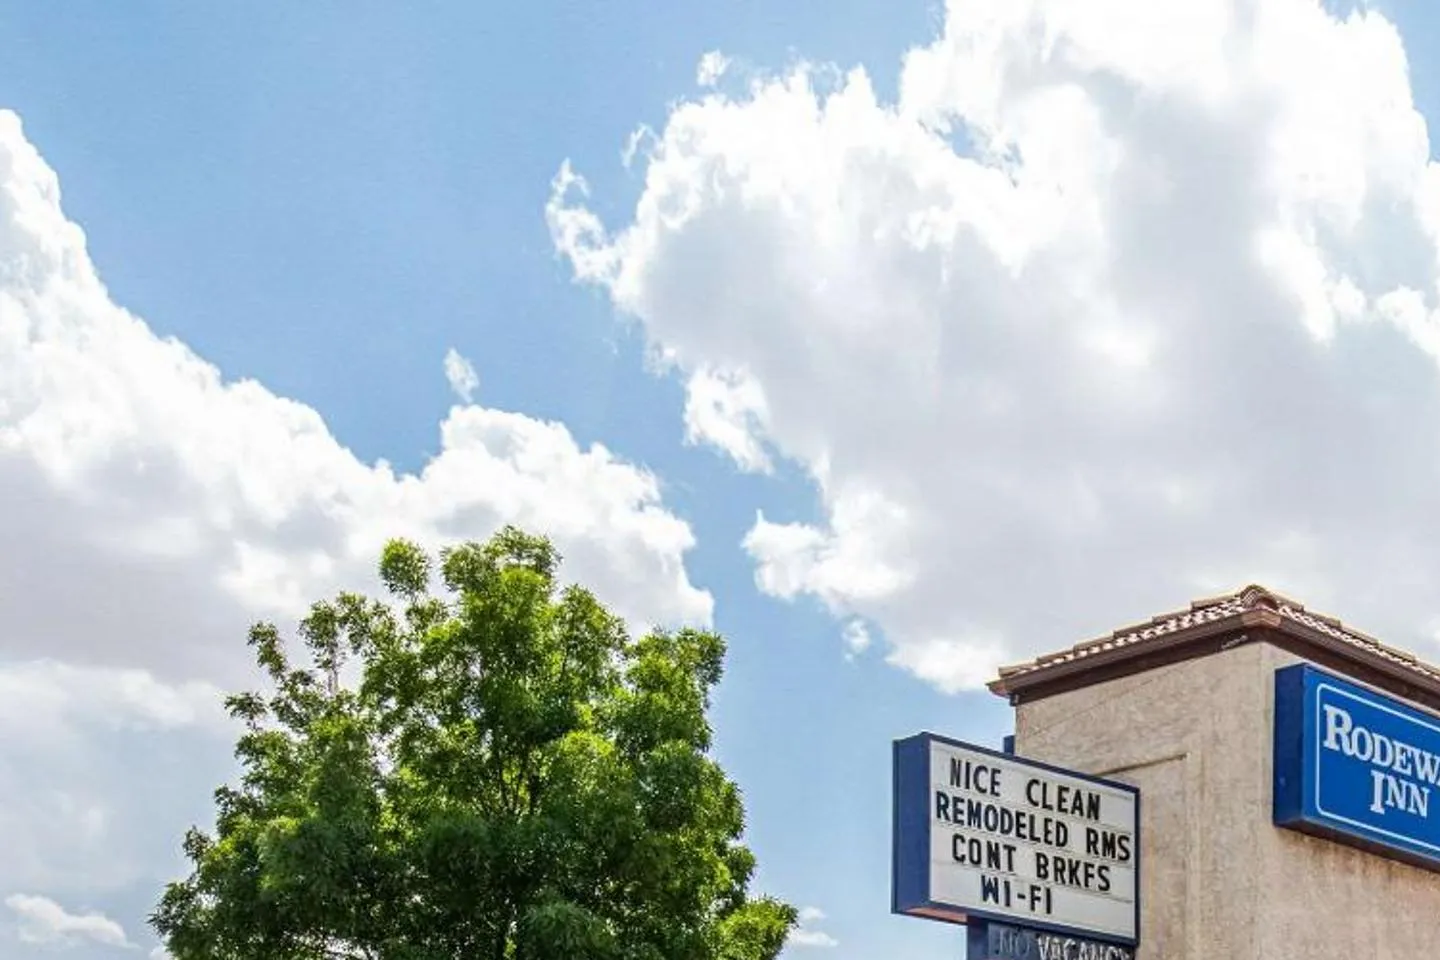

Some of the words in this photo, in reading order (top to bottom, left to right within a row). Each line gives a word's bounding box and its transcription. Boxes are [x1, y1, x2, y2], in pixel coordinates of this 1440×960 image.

[950, 757, 1001, 797] NICE
[1026, 778, 1100, 821] CLEAN
[1370, 769, 1430, 819] INN
[936, 790, 1069, 848] REMODELED
[1086, 827, 1130, 861] RMS
[952, 833, 1017, 872] CONT
[1036, 852, 1110, 892] BRKFS
[981, 875, 1051, 914] WI-FI
